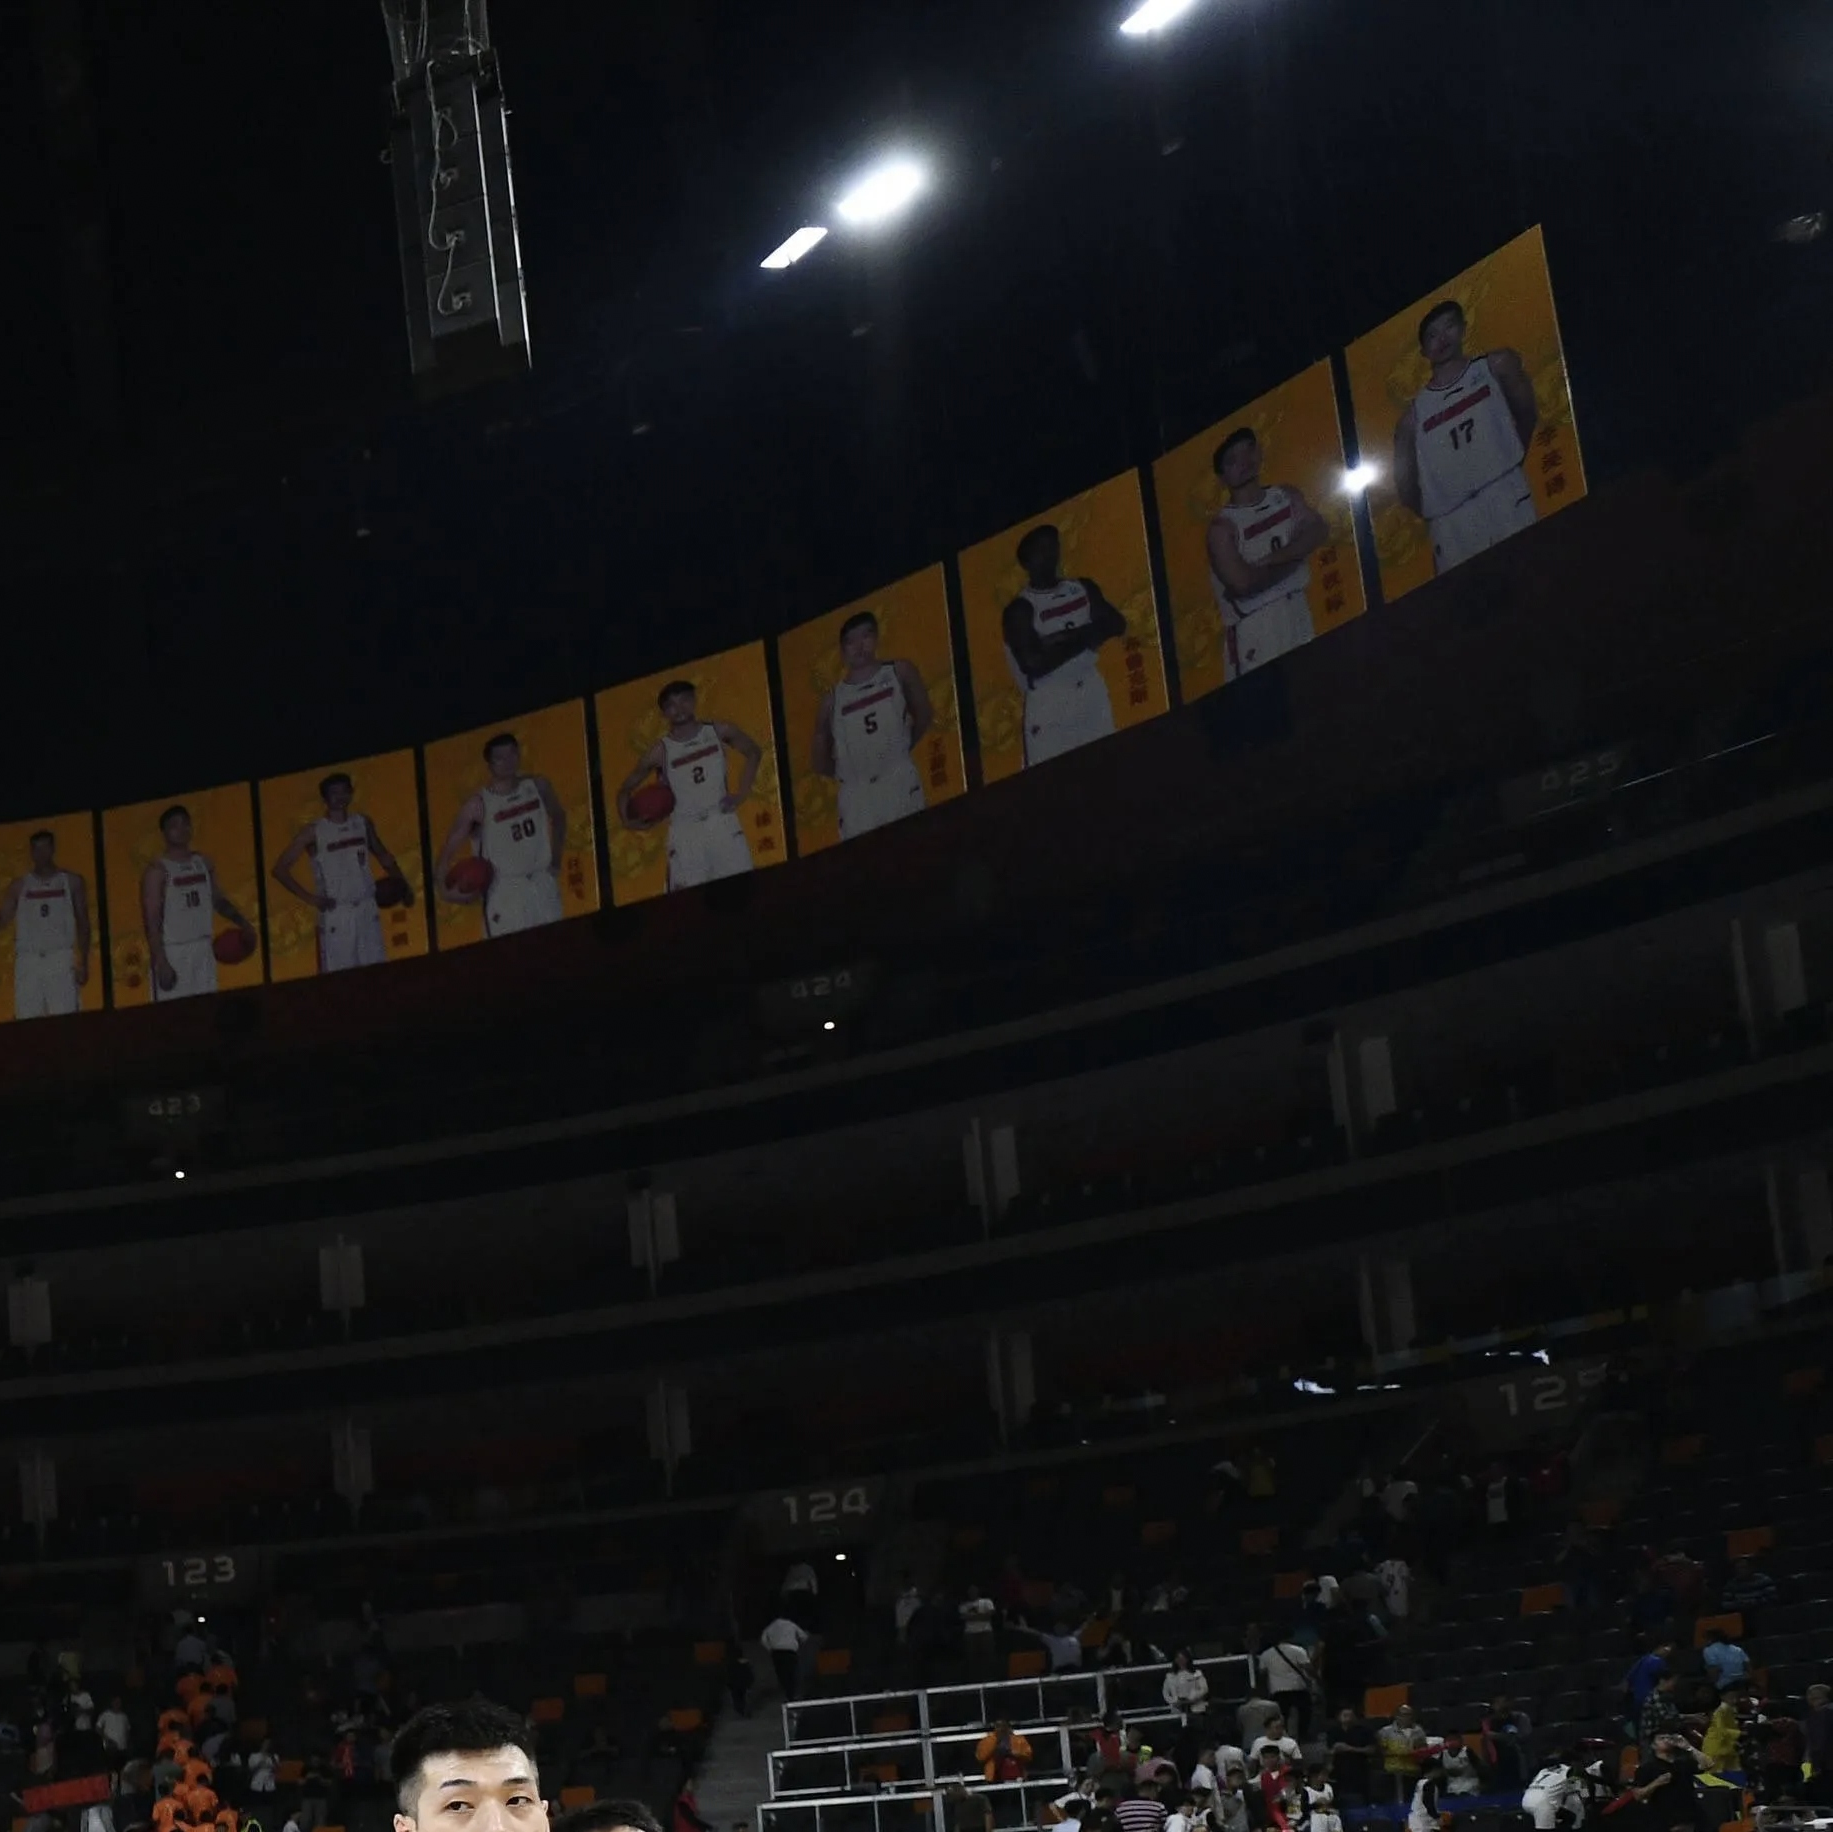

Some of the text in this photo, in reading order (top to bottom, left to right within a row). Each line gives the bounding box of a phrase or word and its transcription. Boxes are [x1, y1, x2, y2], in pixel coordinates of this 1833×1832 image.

[1449, 418, 1475, 450] 17
[147, 1094, 201, 1117] 423
[783, 1486, 871, 1525] 124
[163, 1555, 237, 1587] 123
